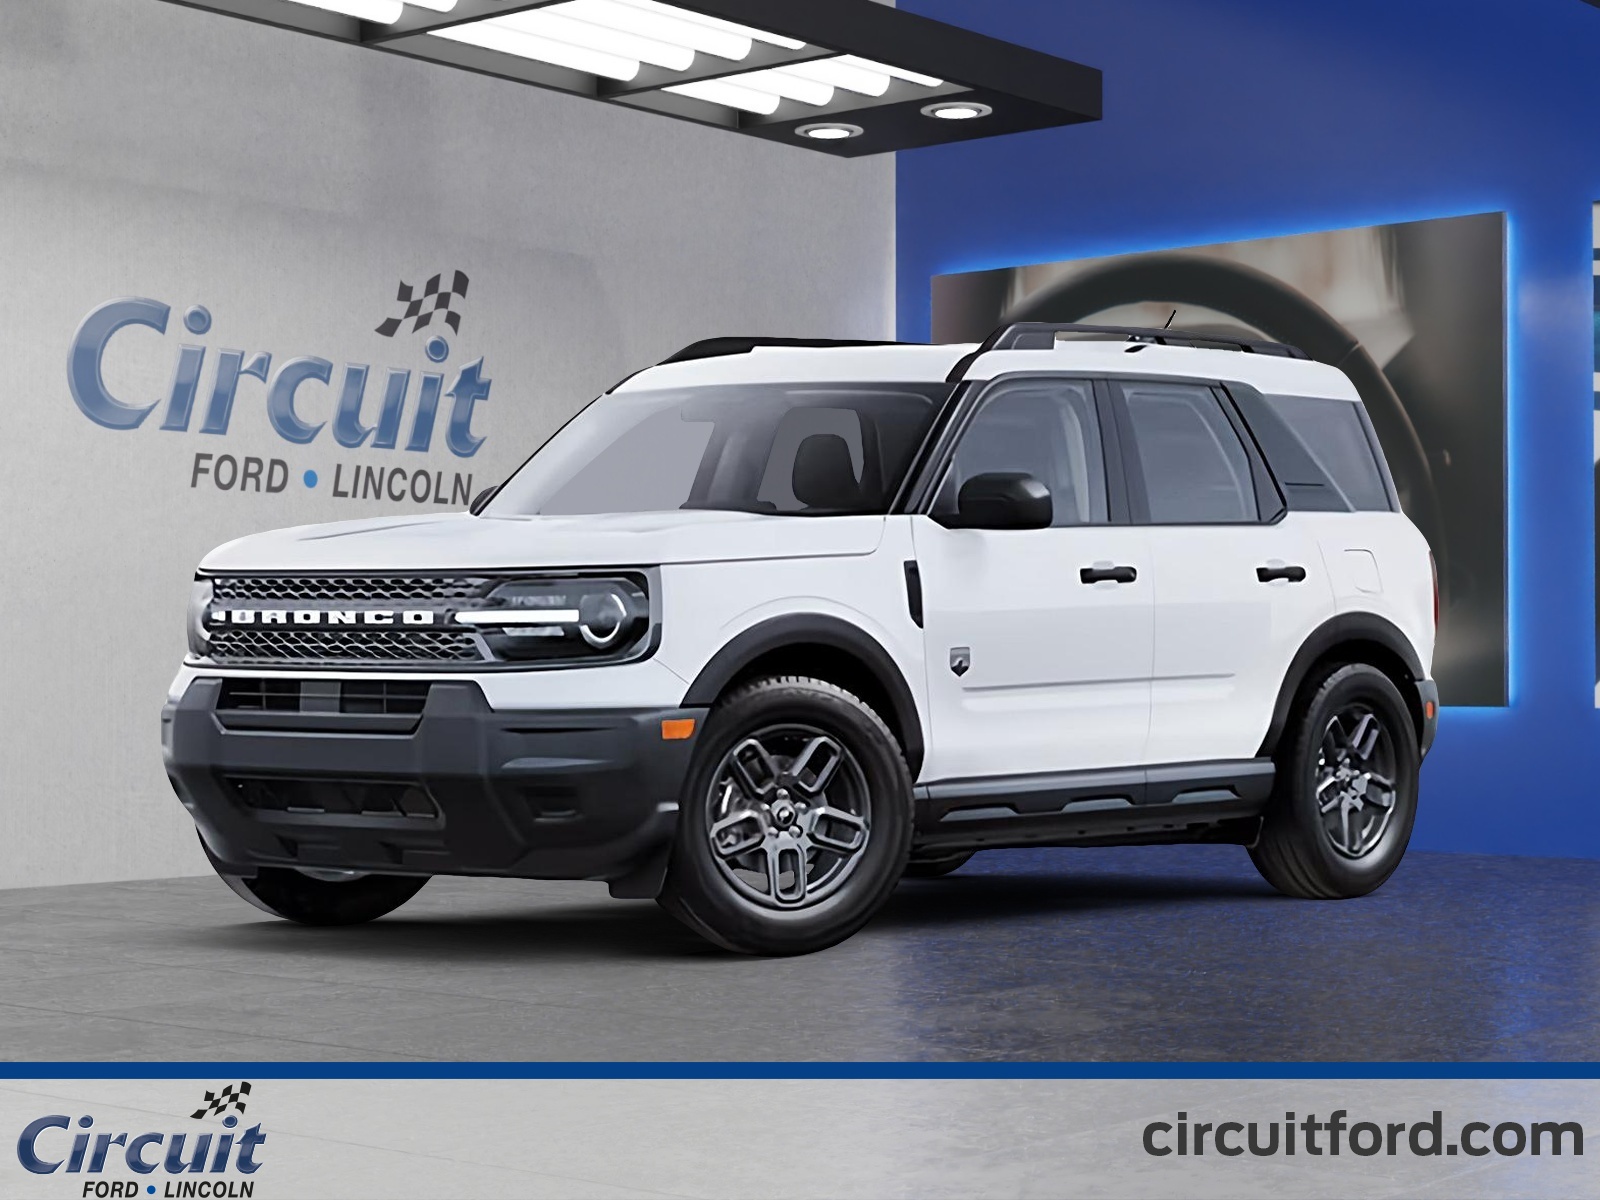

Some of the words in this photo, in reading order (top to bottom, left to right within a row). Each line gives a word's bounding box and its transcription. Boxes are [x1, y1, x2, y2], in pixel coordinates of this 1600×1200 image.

[66, 296, 492, 458] Circuit
[190, 452, 289, 493] FORD
[332, 464, 473, 506] LINCOLN
[231, 610, 434, 624] BRONCO
